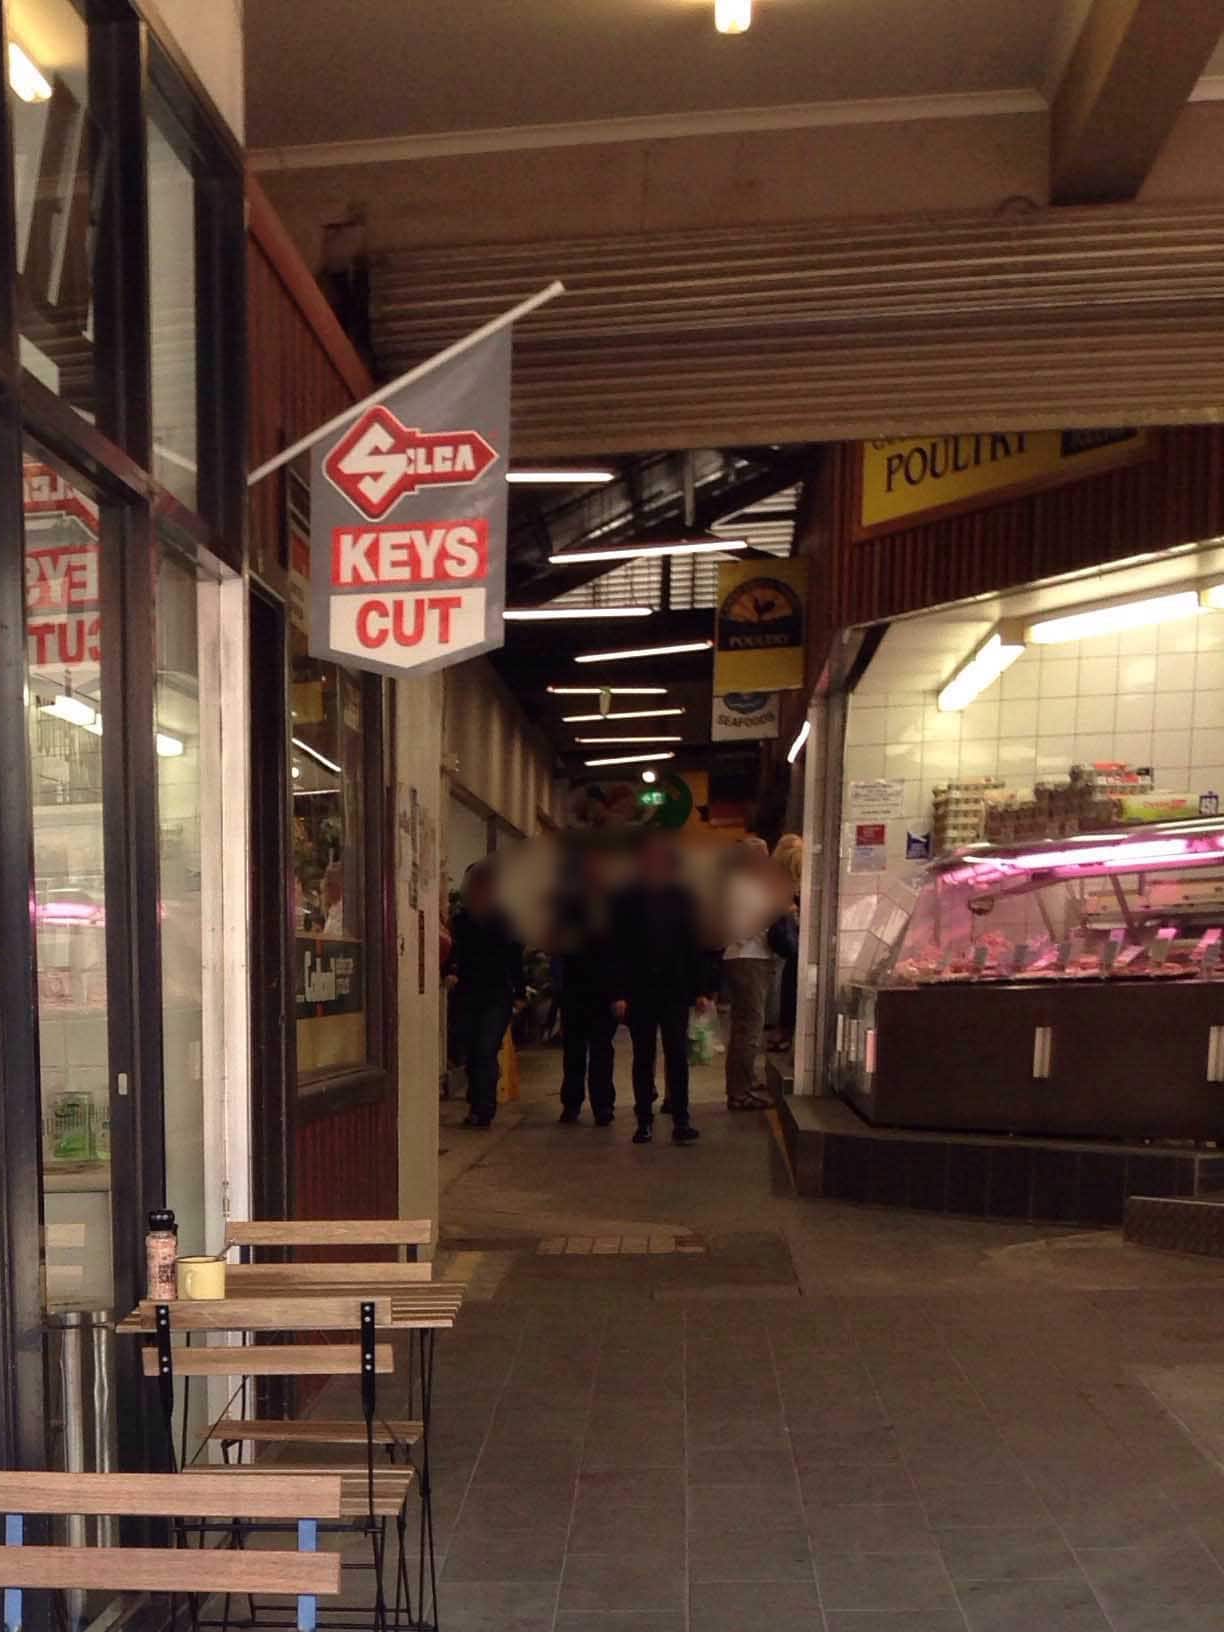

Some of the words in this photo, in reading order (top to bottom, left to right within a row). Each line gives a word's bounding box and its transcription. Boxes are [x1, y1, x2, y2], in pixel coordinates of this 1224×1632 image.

[337, 422, 475, 504] SILCA
[338, 526, 479, 584] KEYS
[356, 596, 462, 648] CUT
